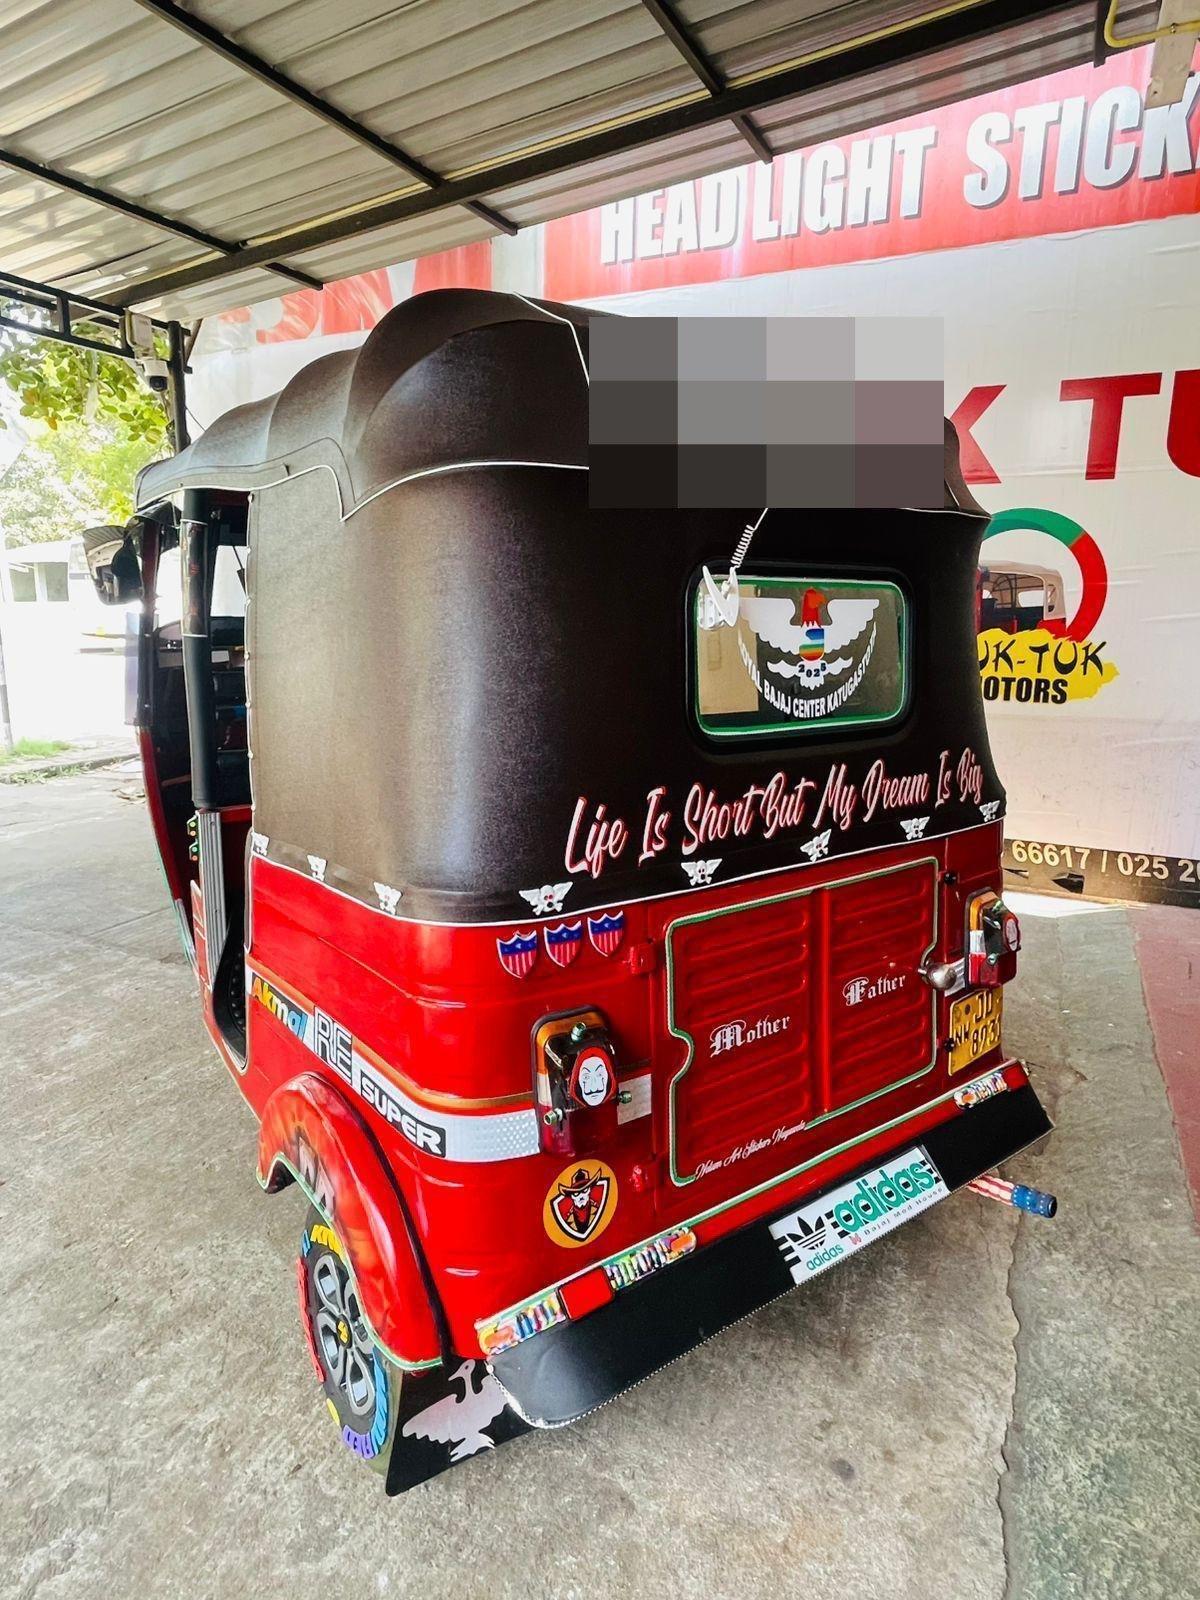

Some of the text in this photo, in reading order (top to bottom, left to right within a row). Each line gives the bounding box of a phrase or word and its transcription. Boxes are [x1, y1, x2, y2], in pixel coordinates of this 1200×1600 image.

[962, 72, 1200, 208] STICK
[763, 678, 792, 716] BAJAJ
[793, 696, 826, 719] CENTER
[981, 676, 1068, 705] OTORS
[637, 785, 671, 867] Is
[682, 782, 765, 856] Short
[760, 771, 816, 839] But
[812, 763, 857, 831] My
[862, 759, 929, 823] Dream
[935, 750, 952, 808] Is
[956, 747, 983, 804] Big
[1011, 840, 1090, 870] 66617
[1117, 852, 1169, 880] 025
[1178, 859, 1200, 883] 2
[710, 974, 906, 1058] Mother Father
[314, 1005, 353, 1086] RE
[362, 1077, 443, 1155] SUPER
[834, 1162, 935, 1233] adidas
[806, 1243, 844, 1271] adidas
